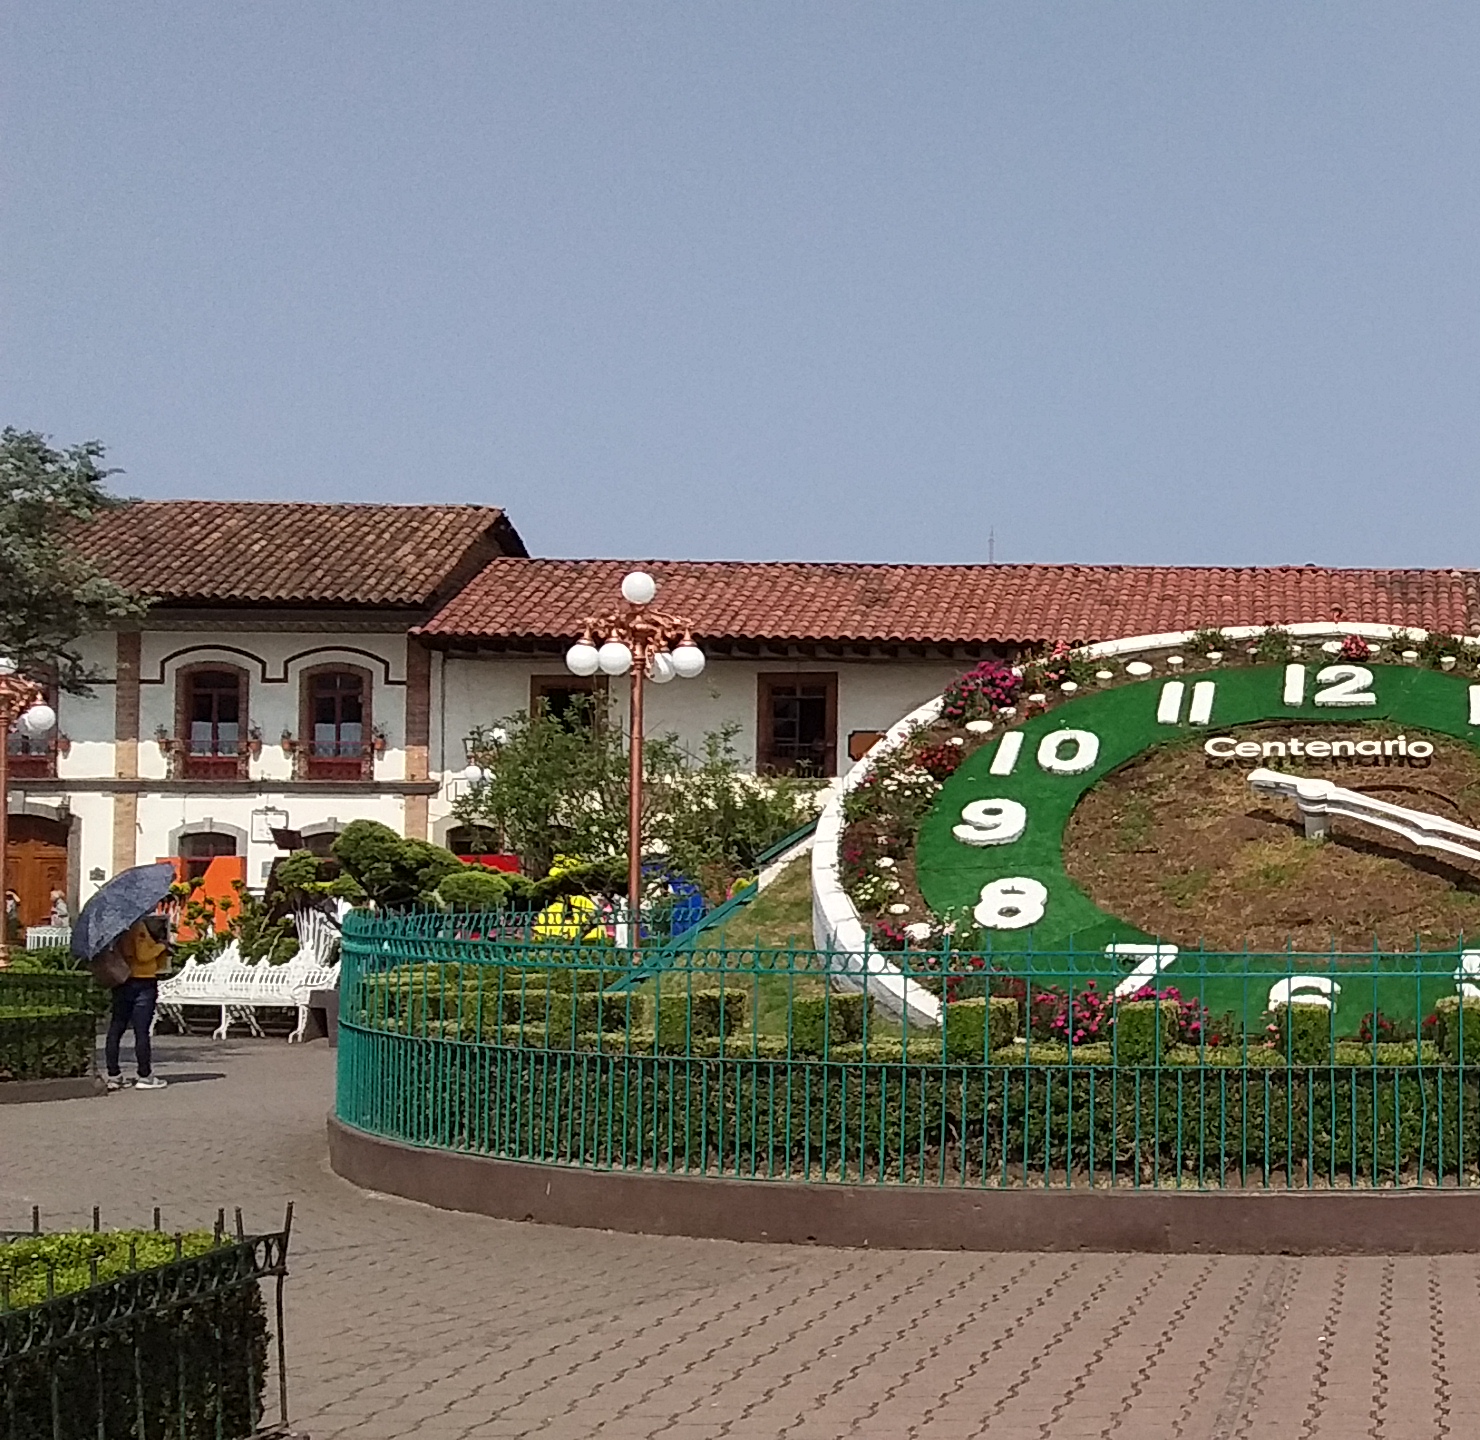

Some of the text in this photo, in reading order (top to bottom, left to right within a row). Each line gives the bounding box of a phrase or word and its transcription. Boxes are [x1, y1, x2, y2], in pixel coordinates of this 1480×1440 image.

[1157, 681, 1216, 725] 11
[1284, 663, 1377, 707] 12
[989, 728, 1100, 776] 10
[1204, 735, 1434, 758] Centenario
[952, 798, 1027, 846] 9
[973, 876, 1048, 929] 8
[1104, 943, 1179, 999] 7
